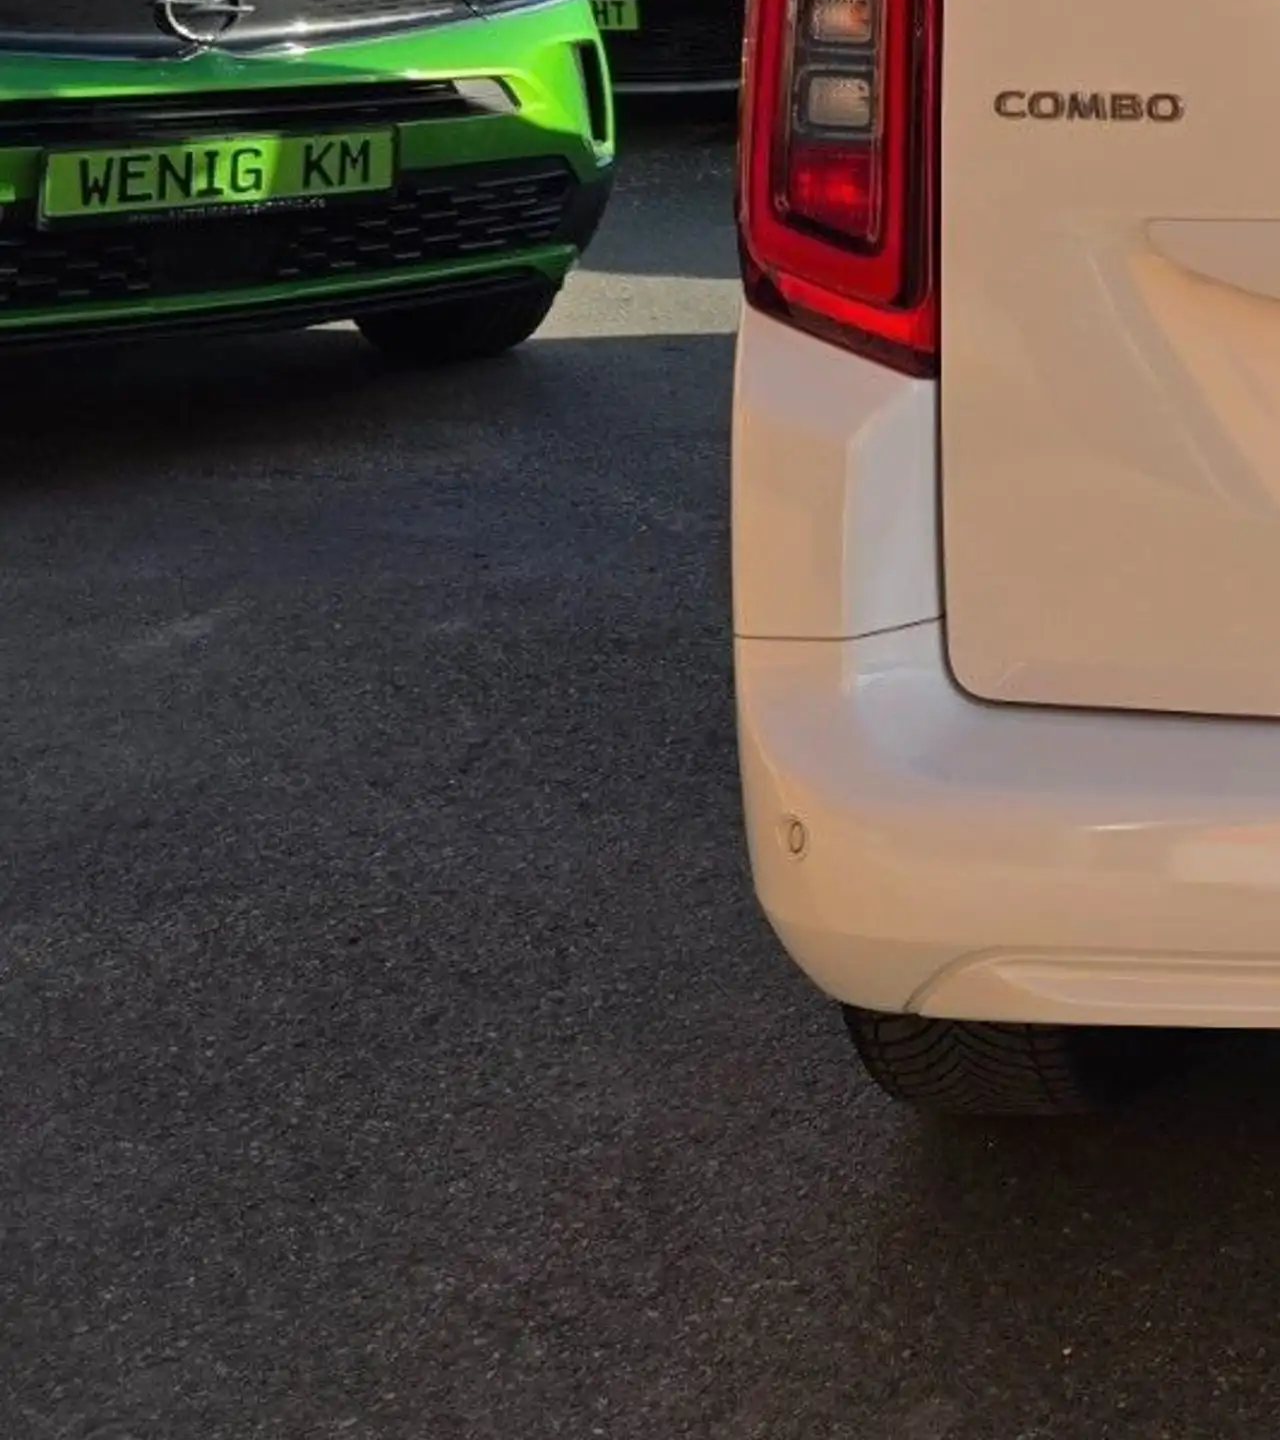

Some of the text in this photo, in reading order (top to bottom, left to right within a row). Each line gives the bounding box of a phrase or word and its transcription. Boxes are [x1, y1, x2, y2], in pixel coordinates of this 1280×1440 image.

[994, 90, 1184, 122] COMBO
[78, 139, 371, 206] WENIG KM
